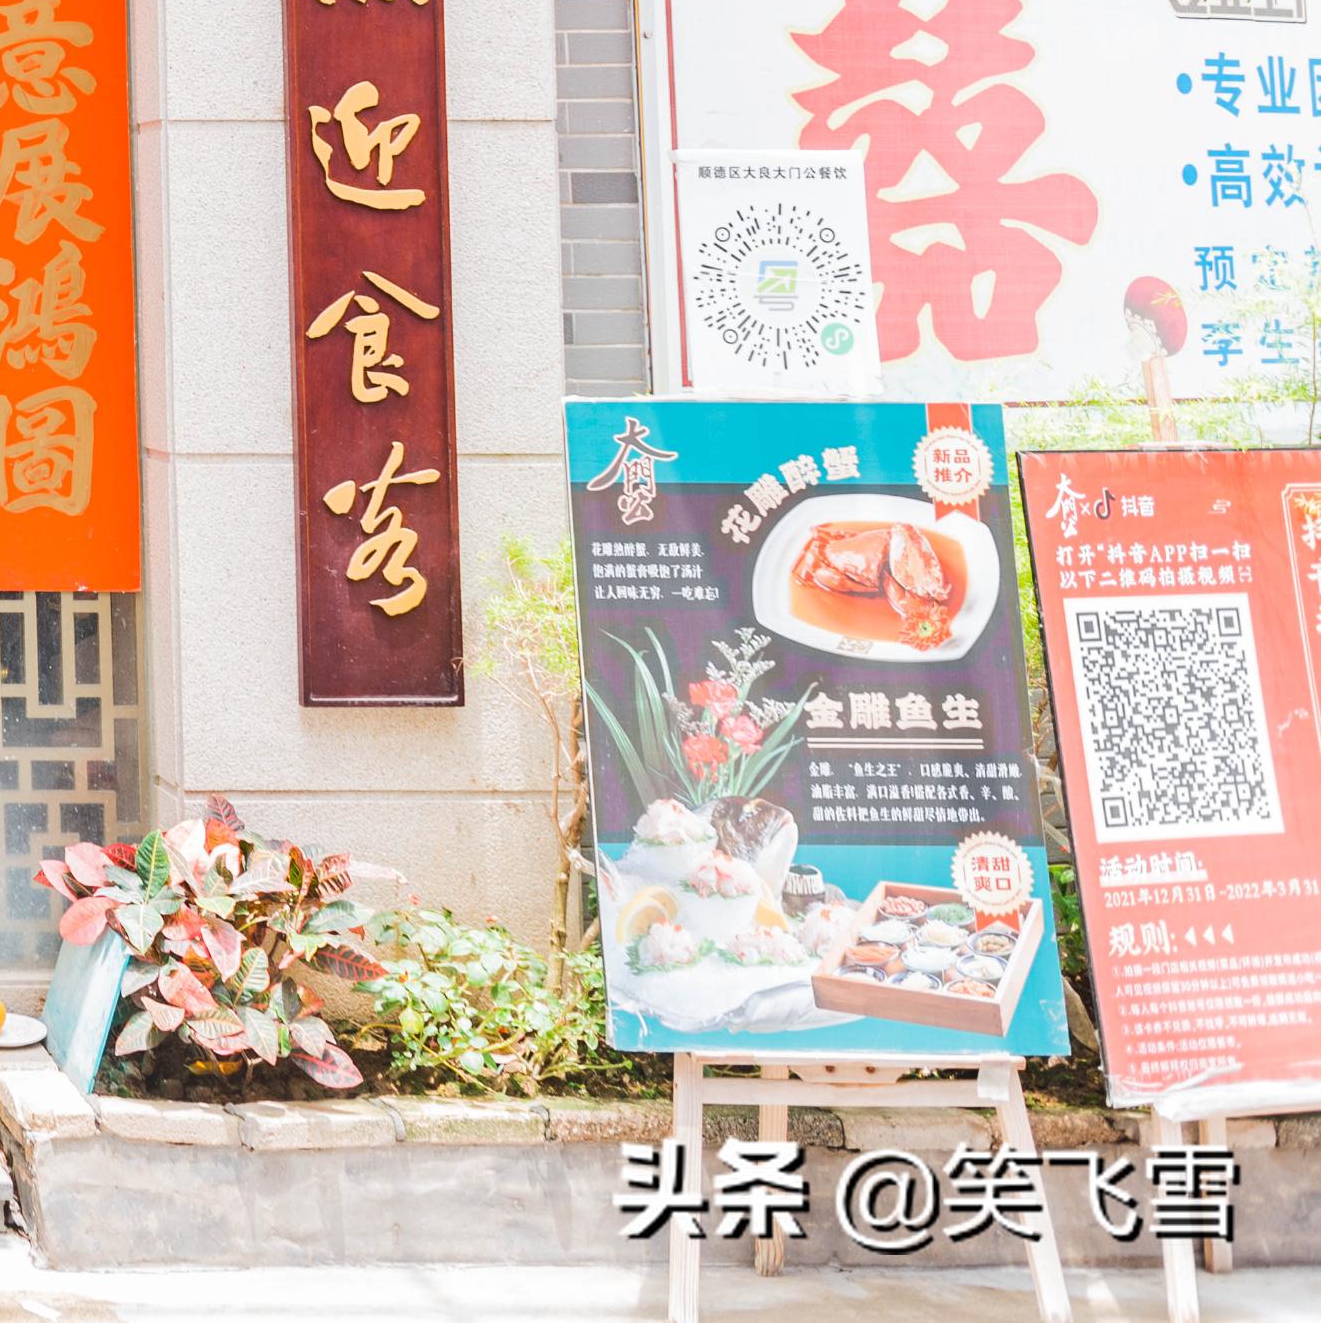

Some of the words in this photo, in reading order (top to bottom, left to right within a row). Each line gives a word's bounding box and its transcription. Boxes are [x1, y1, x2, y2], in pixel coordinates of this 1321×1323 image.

[698, 166, 847, 180] 顺德区大良大门公餐饮
[933, 449, 971, 464] 新品
[587, 417, 678, 525] 大門公
[935, 468, 973, 483] 推介
[721, 445, 862, 545] 花雕醉蟹
[1121, 495, 1155, 518] 抖音
[804, 691, 983, 729] 金雕鱼生
[972, 856, 1010, 872] 清甜
[974, 876, 1011, 891] 爽口
